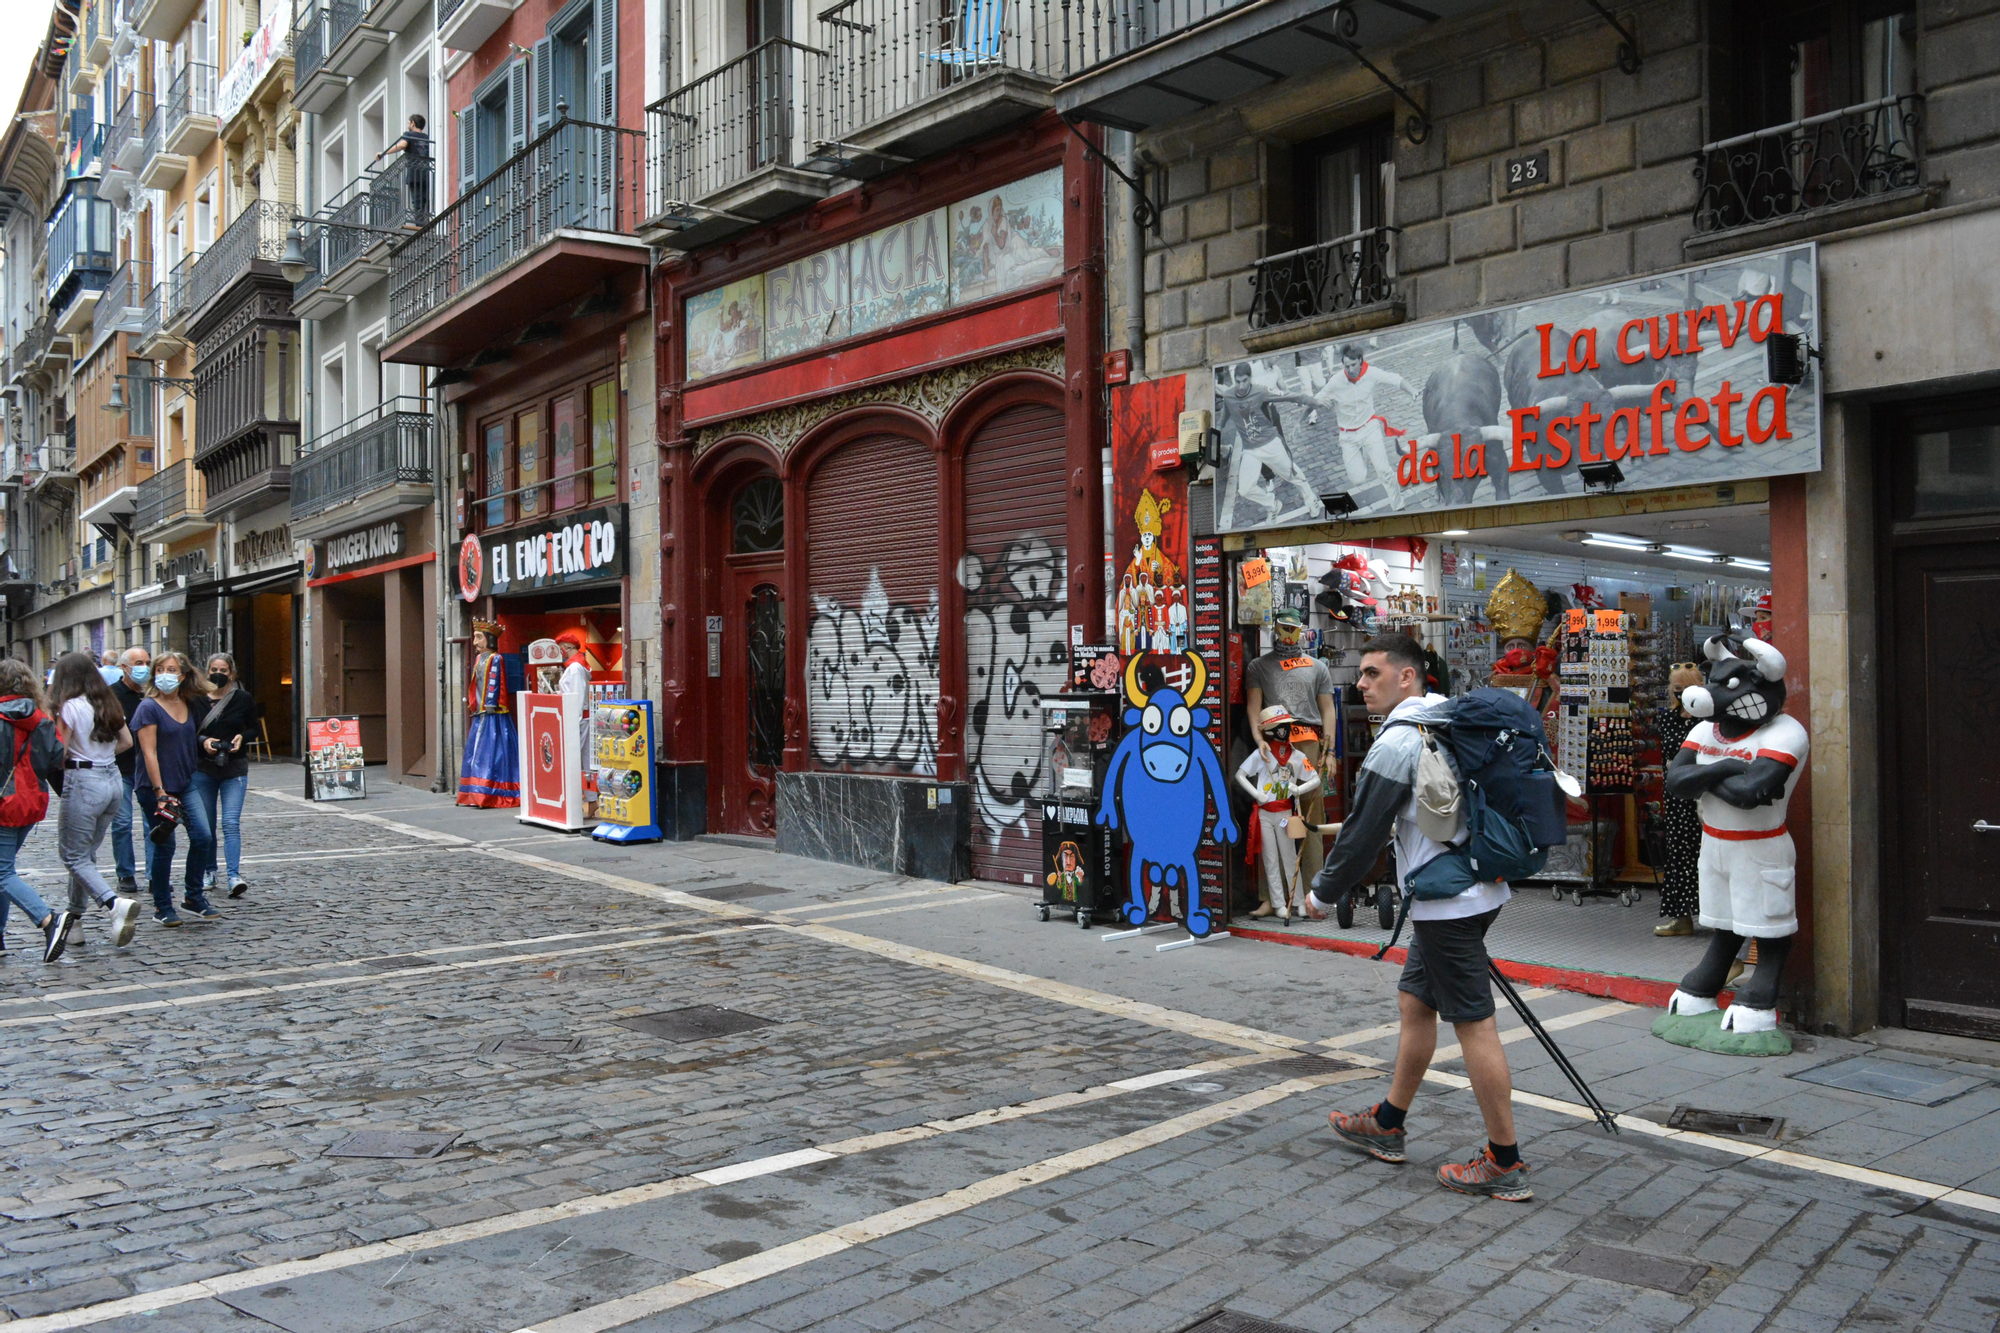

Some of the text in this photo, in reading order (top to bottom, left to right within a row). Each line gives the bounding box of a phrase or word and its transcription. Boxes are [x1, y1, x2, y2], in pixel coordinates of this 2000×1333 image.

[1511, 159, 1538, 183] 23
[767, 212, 945, 331] FARMACIA
[1536, 292, 1786, 379] La curva
[1397, 379, 1793, 486] de la Estafeta
[1157, 446, 1179, 458] prodein
[327, 531, 368, 569] BURGER
[369, 522, 398, 559] KING
[492, 543, 511, 585] EL
[1195, 556, 1219, 564] bocadillos
[1246, 564, 1267, 580] 3,99€
[1196, 584, 1219, 592] souvenir
[1195, 603, 1219, 611] bocadillos
[709, 617, 721, 630] 21
[1042, 804, 1045, 821] I
[1104, 825, 1113, 877] SOUVENI
[1199, 859, 1223, 867] camisetas
